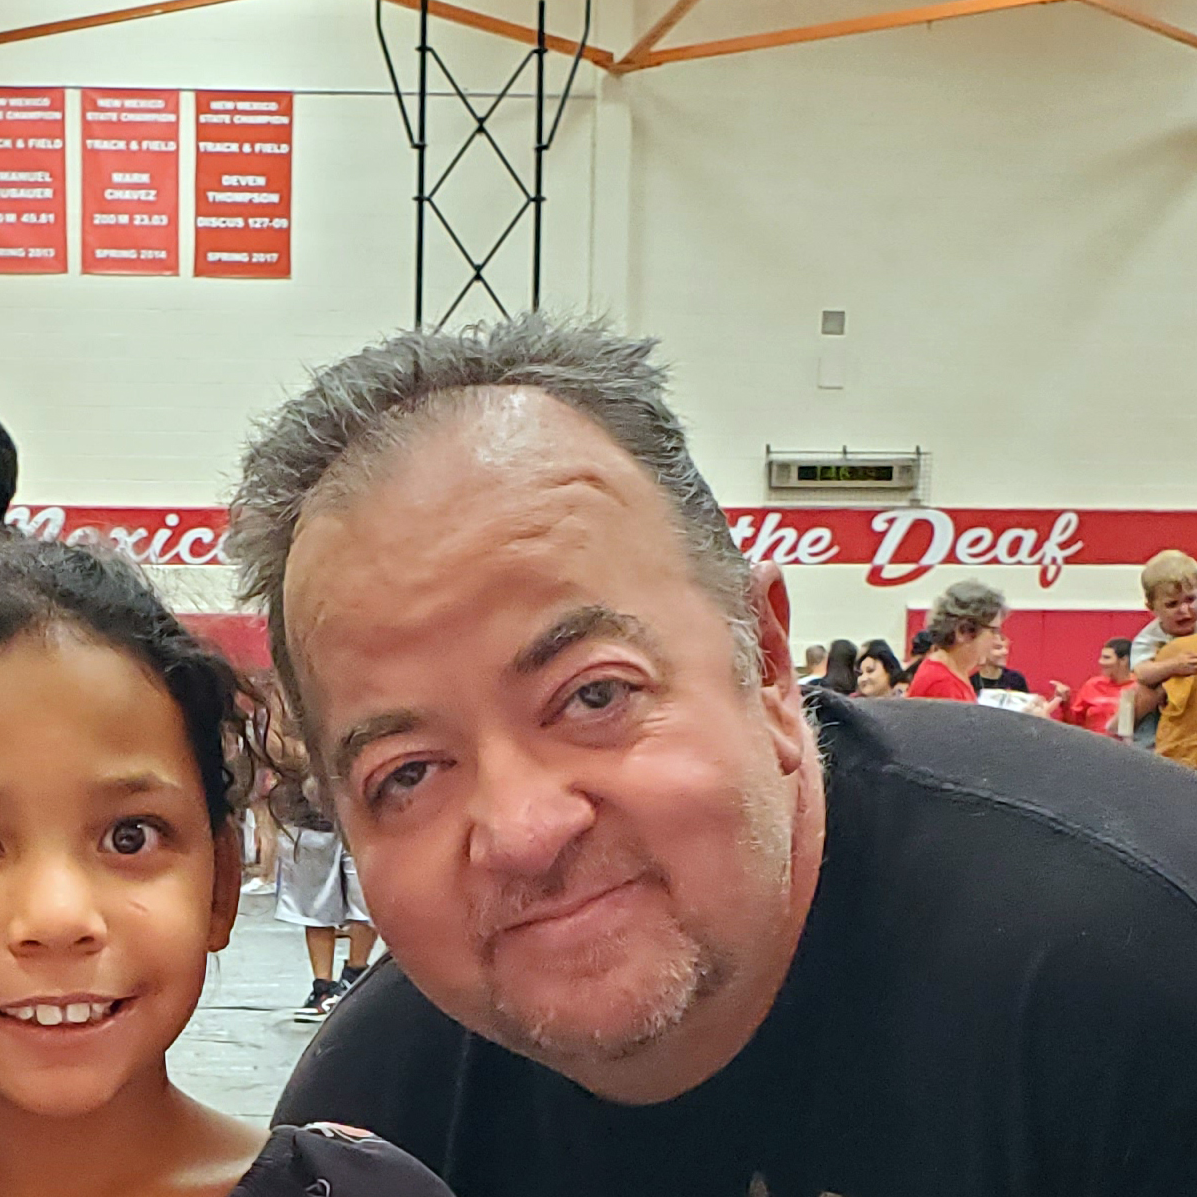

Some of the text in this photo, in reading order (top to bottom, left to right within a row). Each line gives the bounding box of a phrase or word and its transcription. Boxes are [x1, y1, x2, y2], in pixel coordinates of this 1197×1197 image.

[15, 138, 25, 149] &
[28, 138, 63, 150] FIELD
[85, 139, 177, 151] TRACK & FIELD
[198, 141, 290, 154] TRACK & FIELD
[728, 512, 840, 564] the
[865, 508, 1084, 589] Deaf
